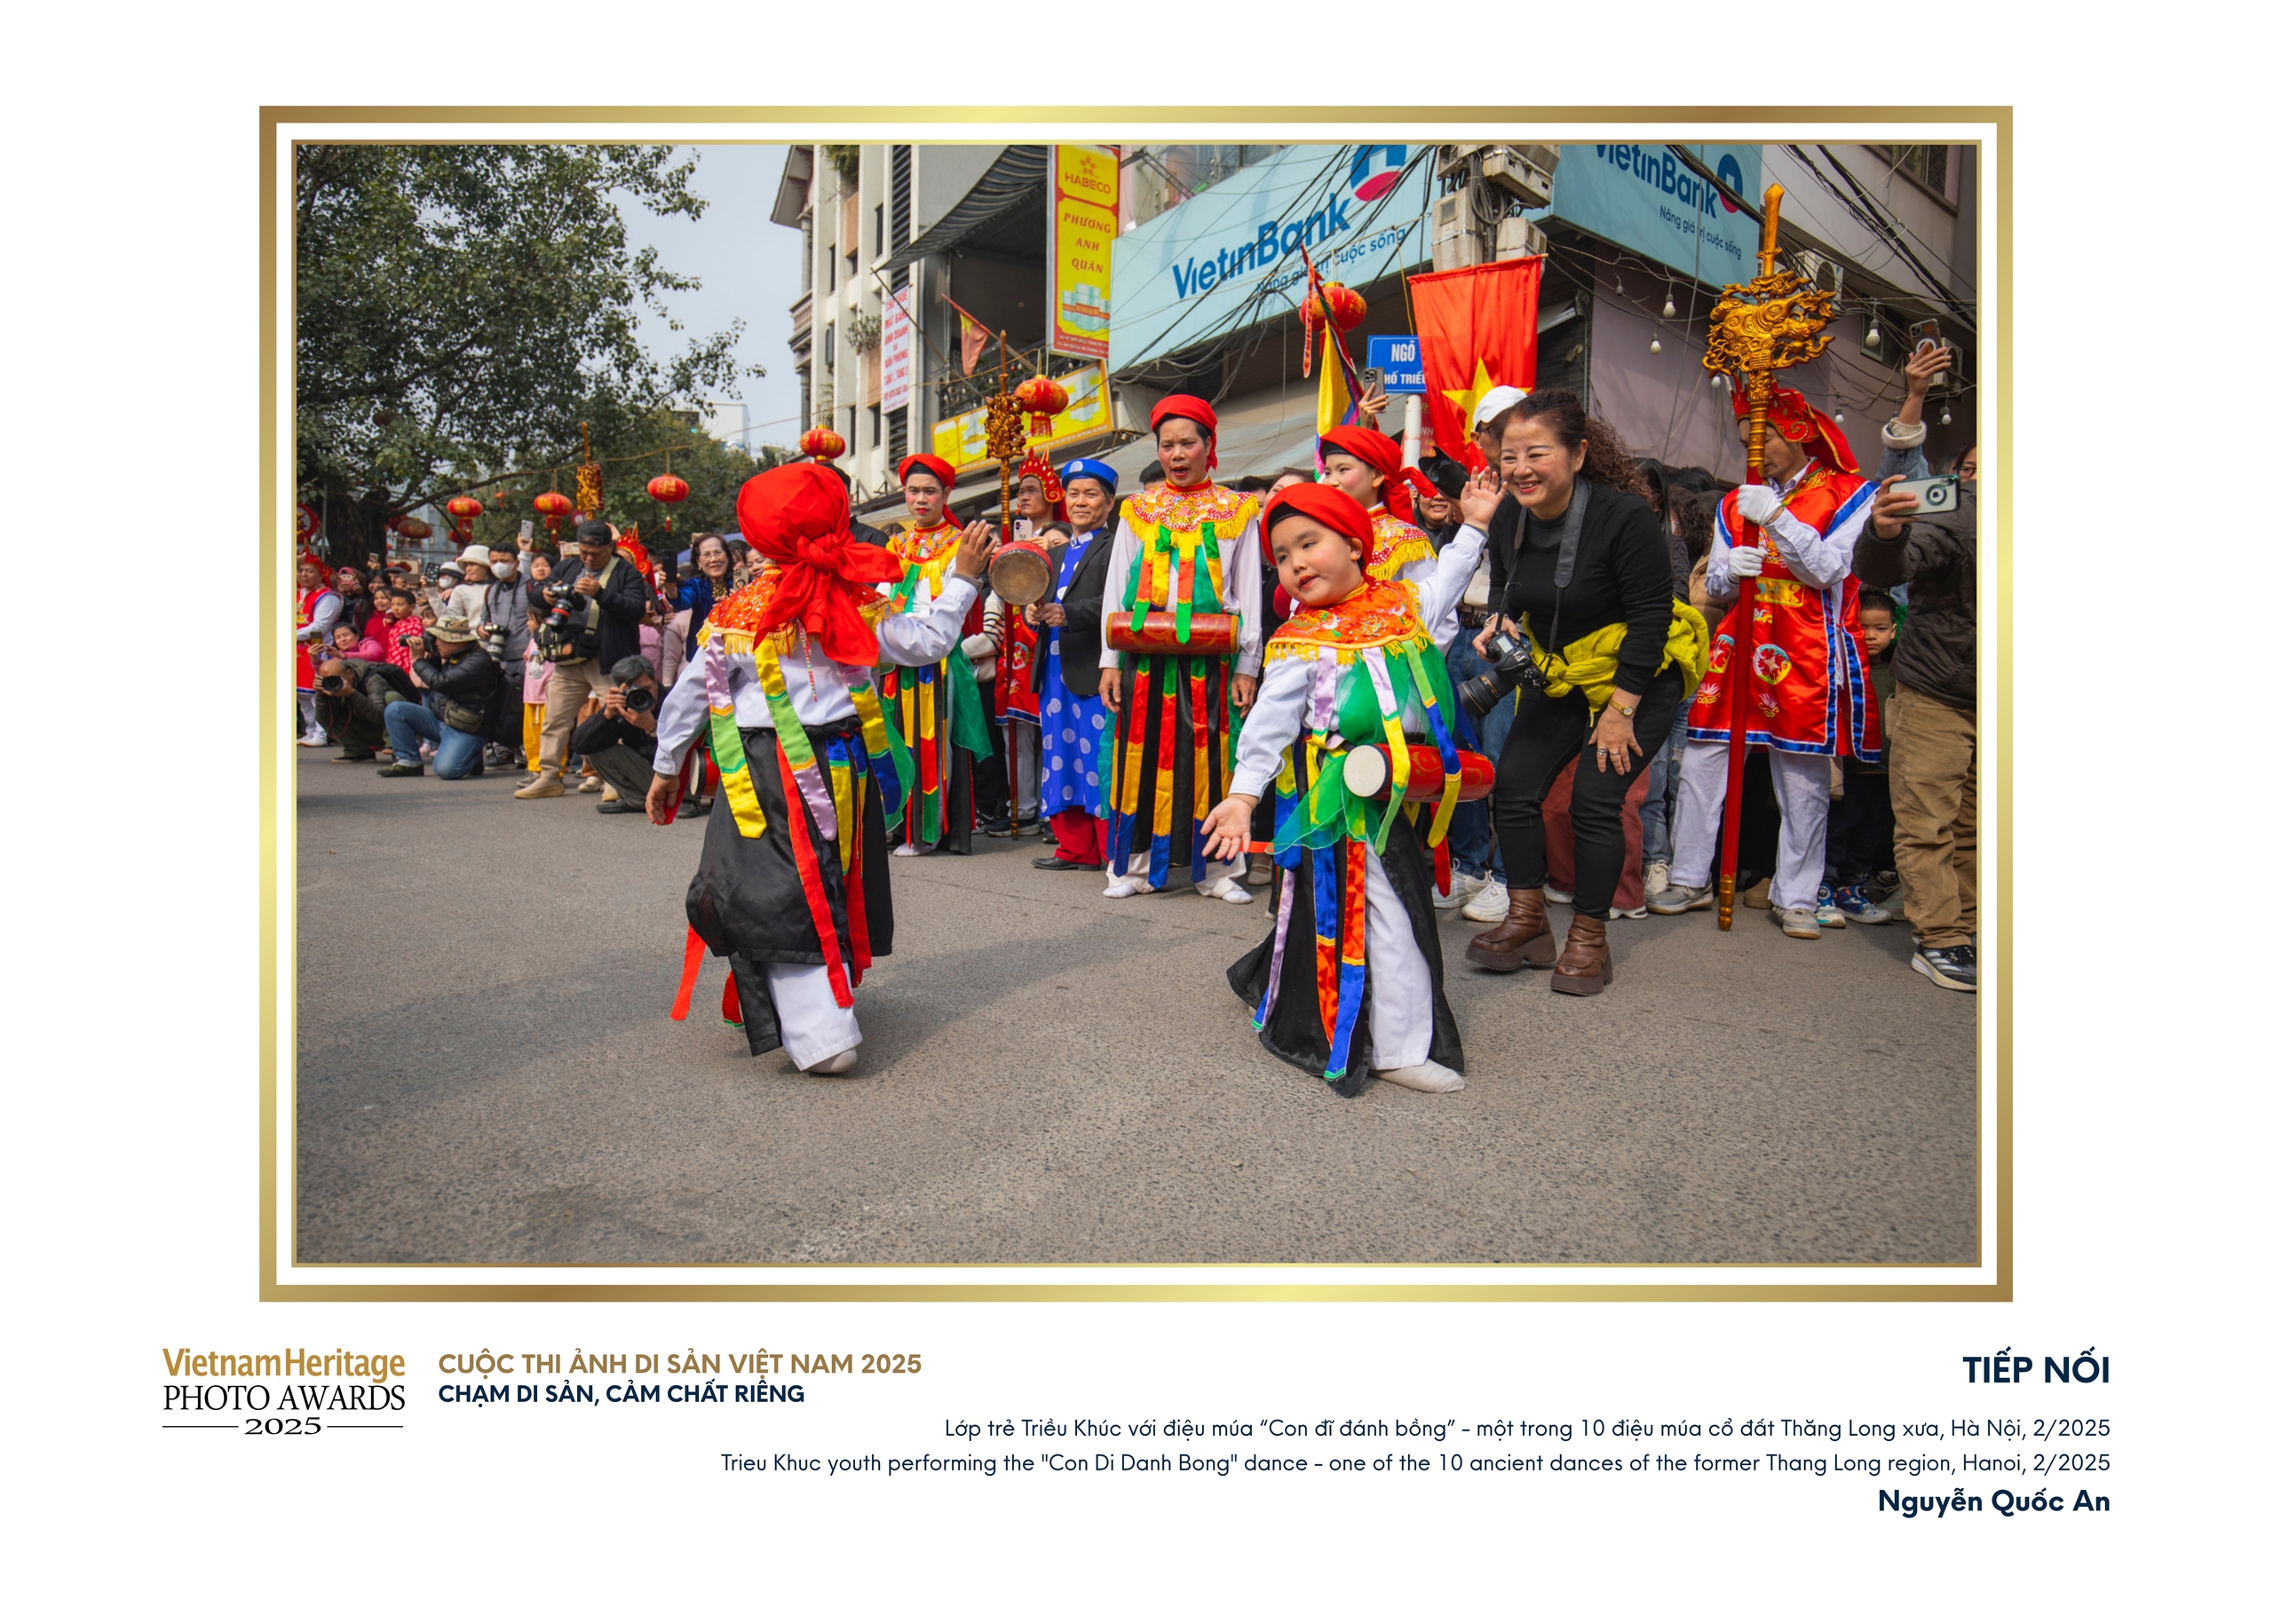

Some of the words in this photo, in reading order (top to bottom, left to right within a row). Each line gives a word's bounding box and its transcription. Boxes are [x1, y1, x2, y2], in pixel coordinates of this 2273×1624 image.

[1065, 171, 1111, 194] HABECO
[1064, 212, 1112, 234] PHƯƠNG
[1659, 204, 1681, 230] Nâng
[1683, 219, 1696, 234] giá
[1706, 234, 1724, 250] cuộc
[1725, 240, 1742, 261] sống
[1075, 238, 1100, 251] ANH
[1172, 192, 1351, 300] VietinBank
[1072, 257, 1104, 274] QUÁN
[1390, 339, 1416, 362] NGÕ
[1384, 369, 1399, 384] HỐ
